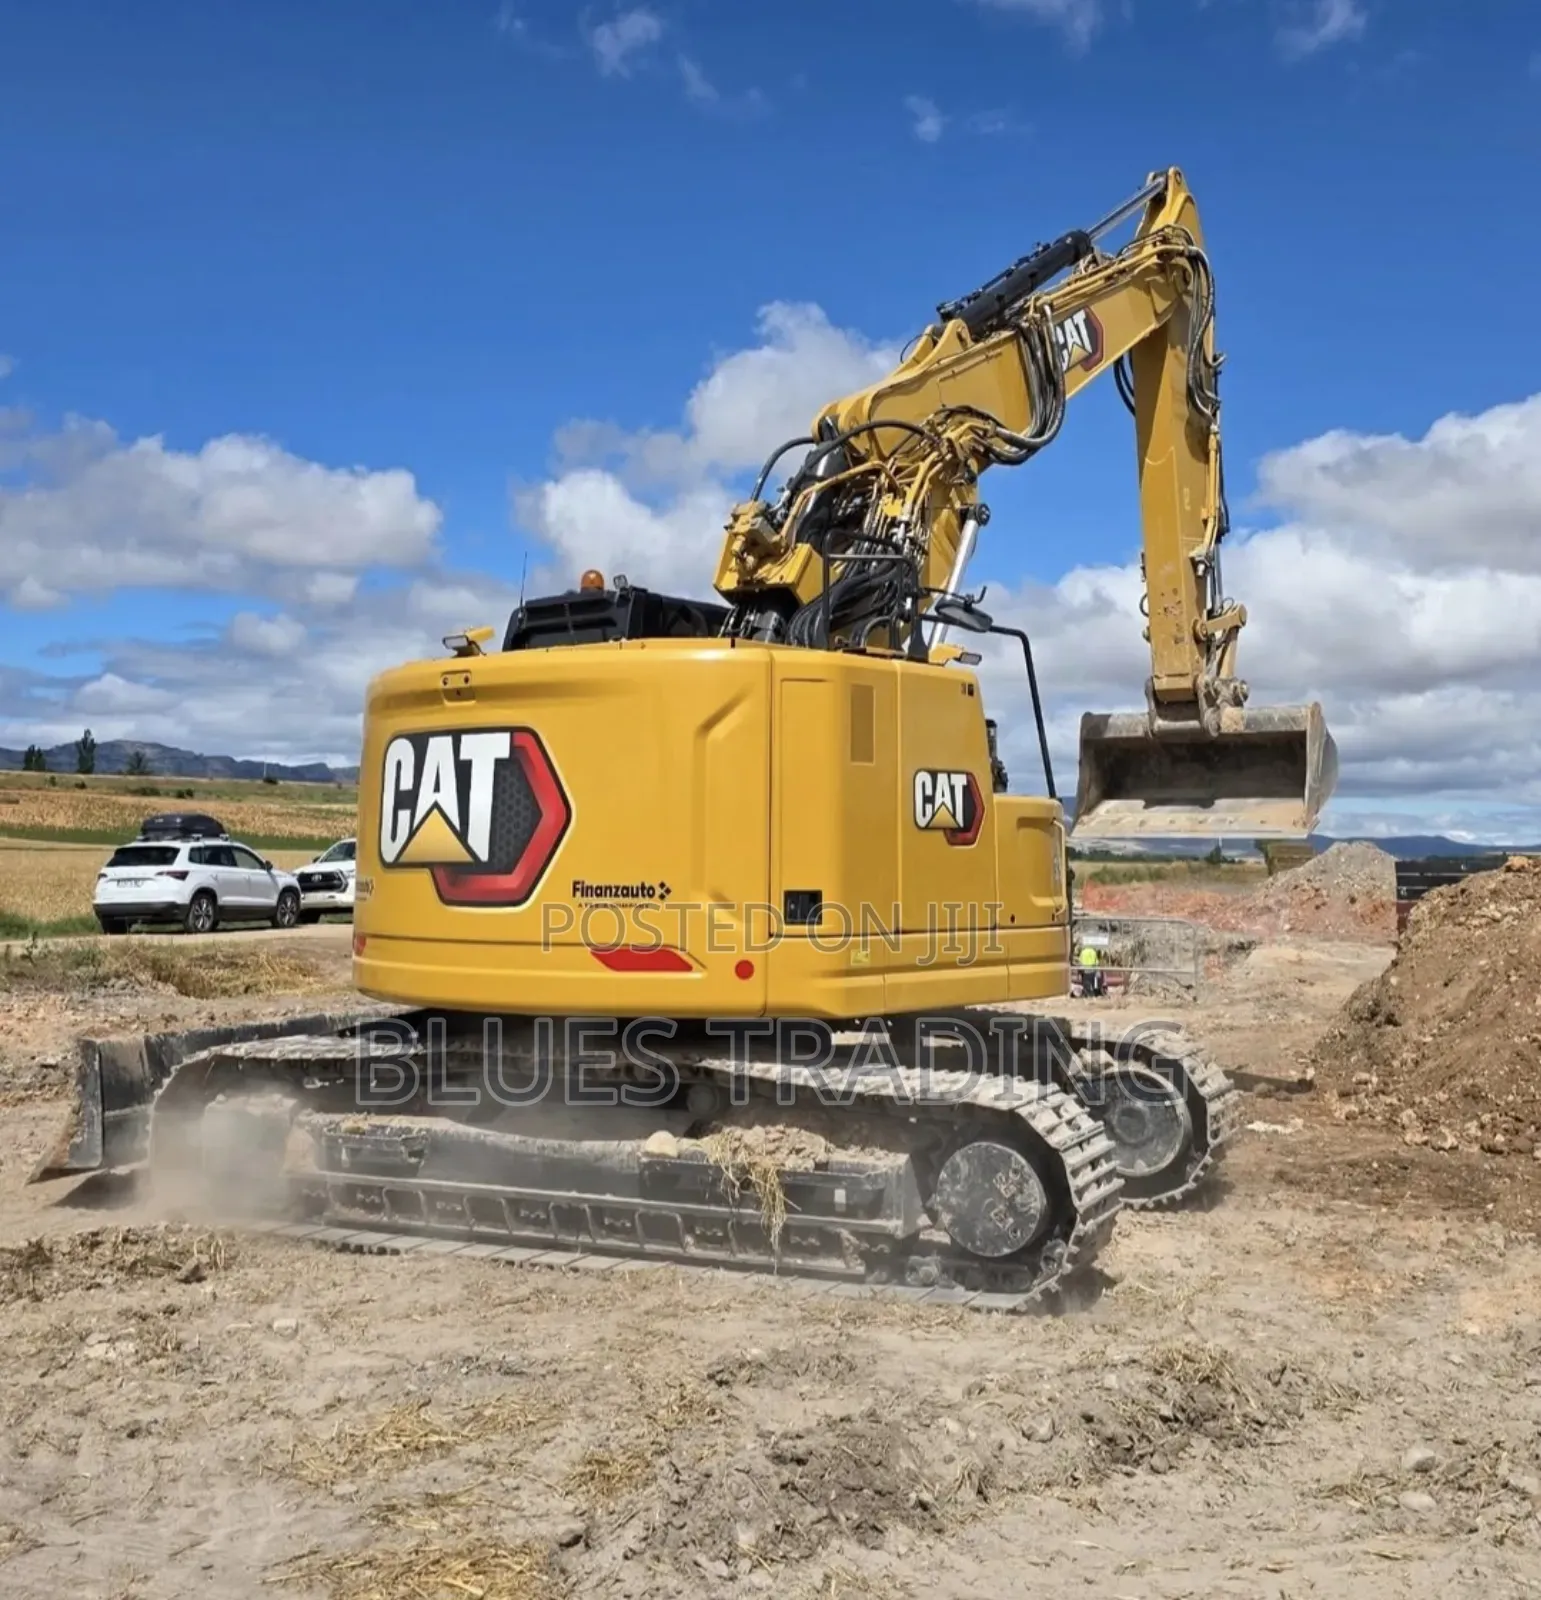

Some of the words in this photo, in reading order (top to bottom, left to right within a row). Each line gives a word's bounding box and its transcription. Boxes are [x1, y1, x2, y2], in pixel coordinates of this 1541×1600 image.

[380, 732, 511, 864] CAT
[914, 770, 968, 829] CAT
[572, 880, 656, 899] Finanzauto
